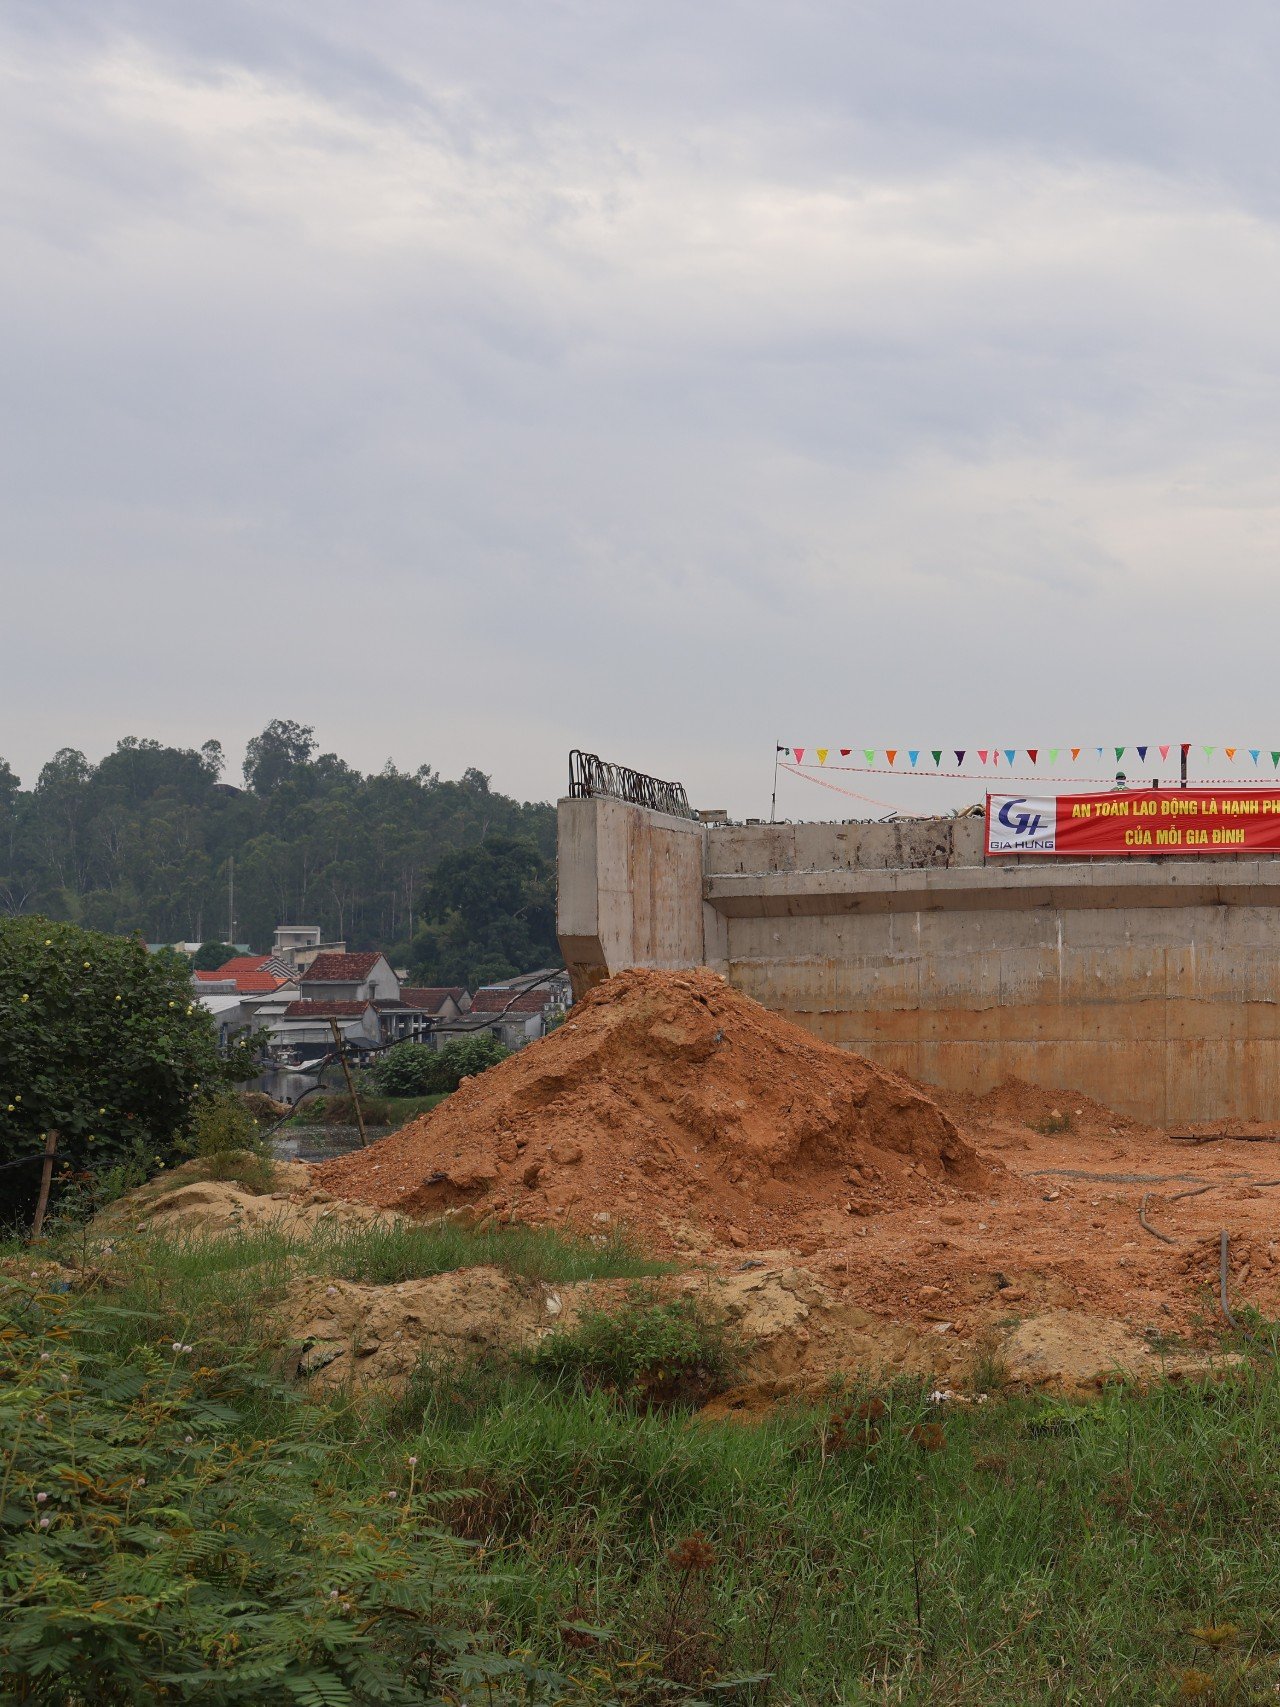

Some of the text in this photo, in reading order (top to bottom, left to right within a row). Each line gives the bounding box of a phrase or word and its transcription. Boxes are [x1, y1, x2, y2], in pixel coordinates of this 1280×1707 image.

[1072, 803, 1091, 817] AN
[1095, 800, 1129, 817] TOÀN
[1133, 801, 1157, 815] LAO
[1161, 798, 1198, 818] ĐỘNG
[1201, 798, 1218, 815] LÀ
[1222, 800, 1259, 817] HẠNH
[990, 840, 1054, 849] GIA HƯNG
[1125, 824, 1245, 845] CỦA MỖI GIA ĐÌNH
